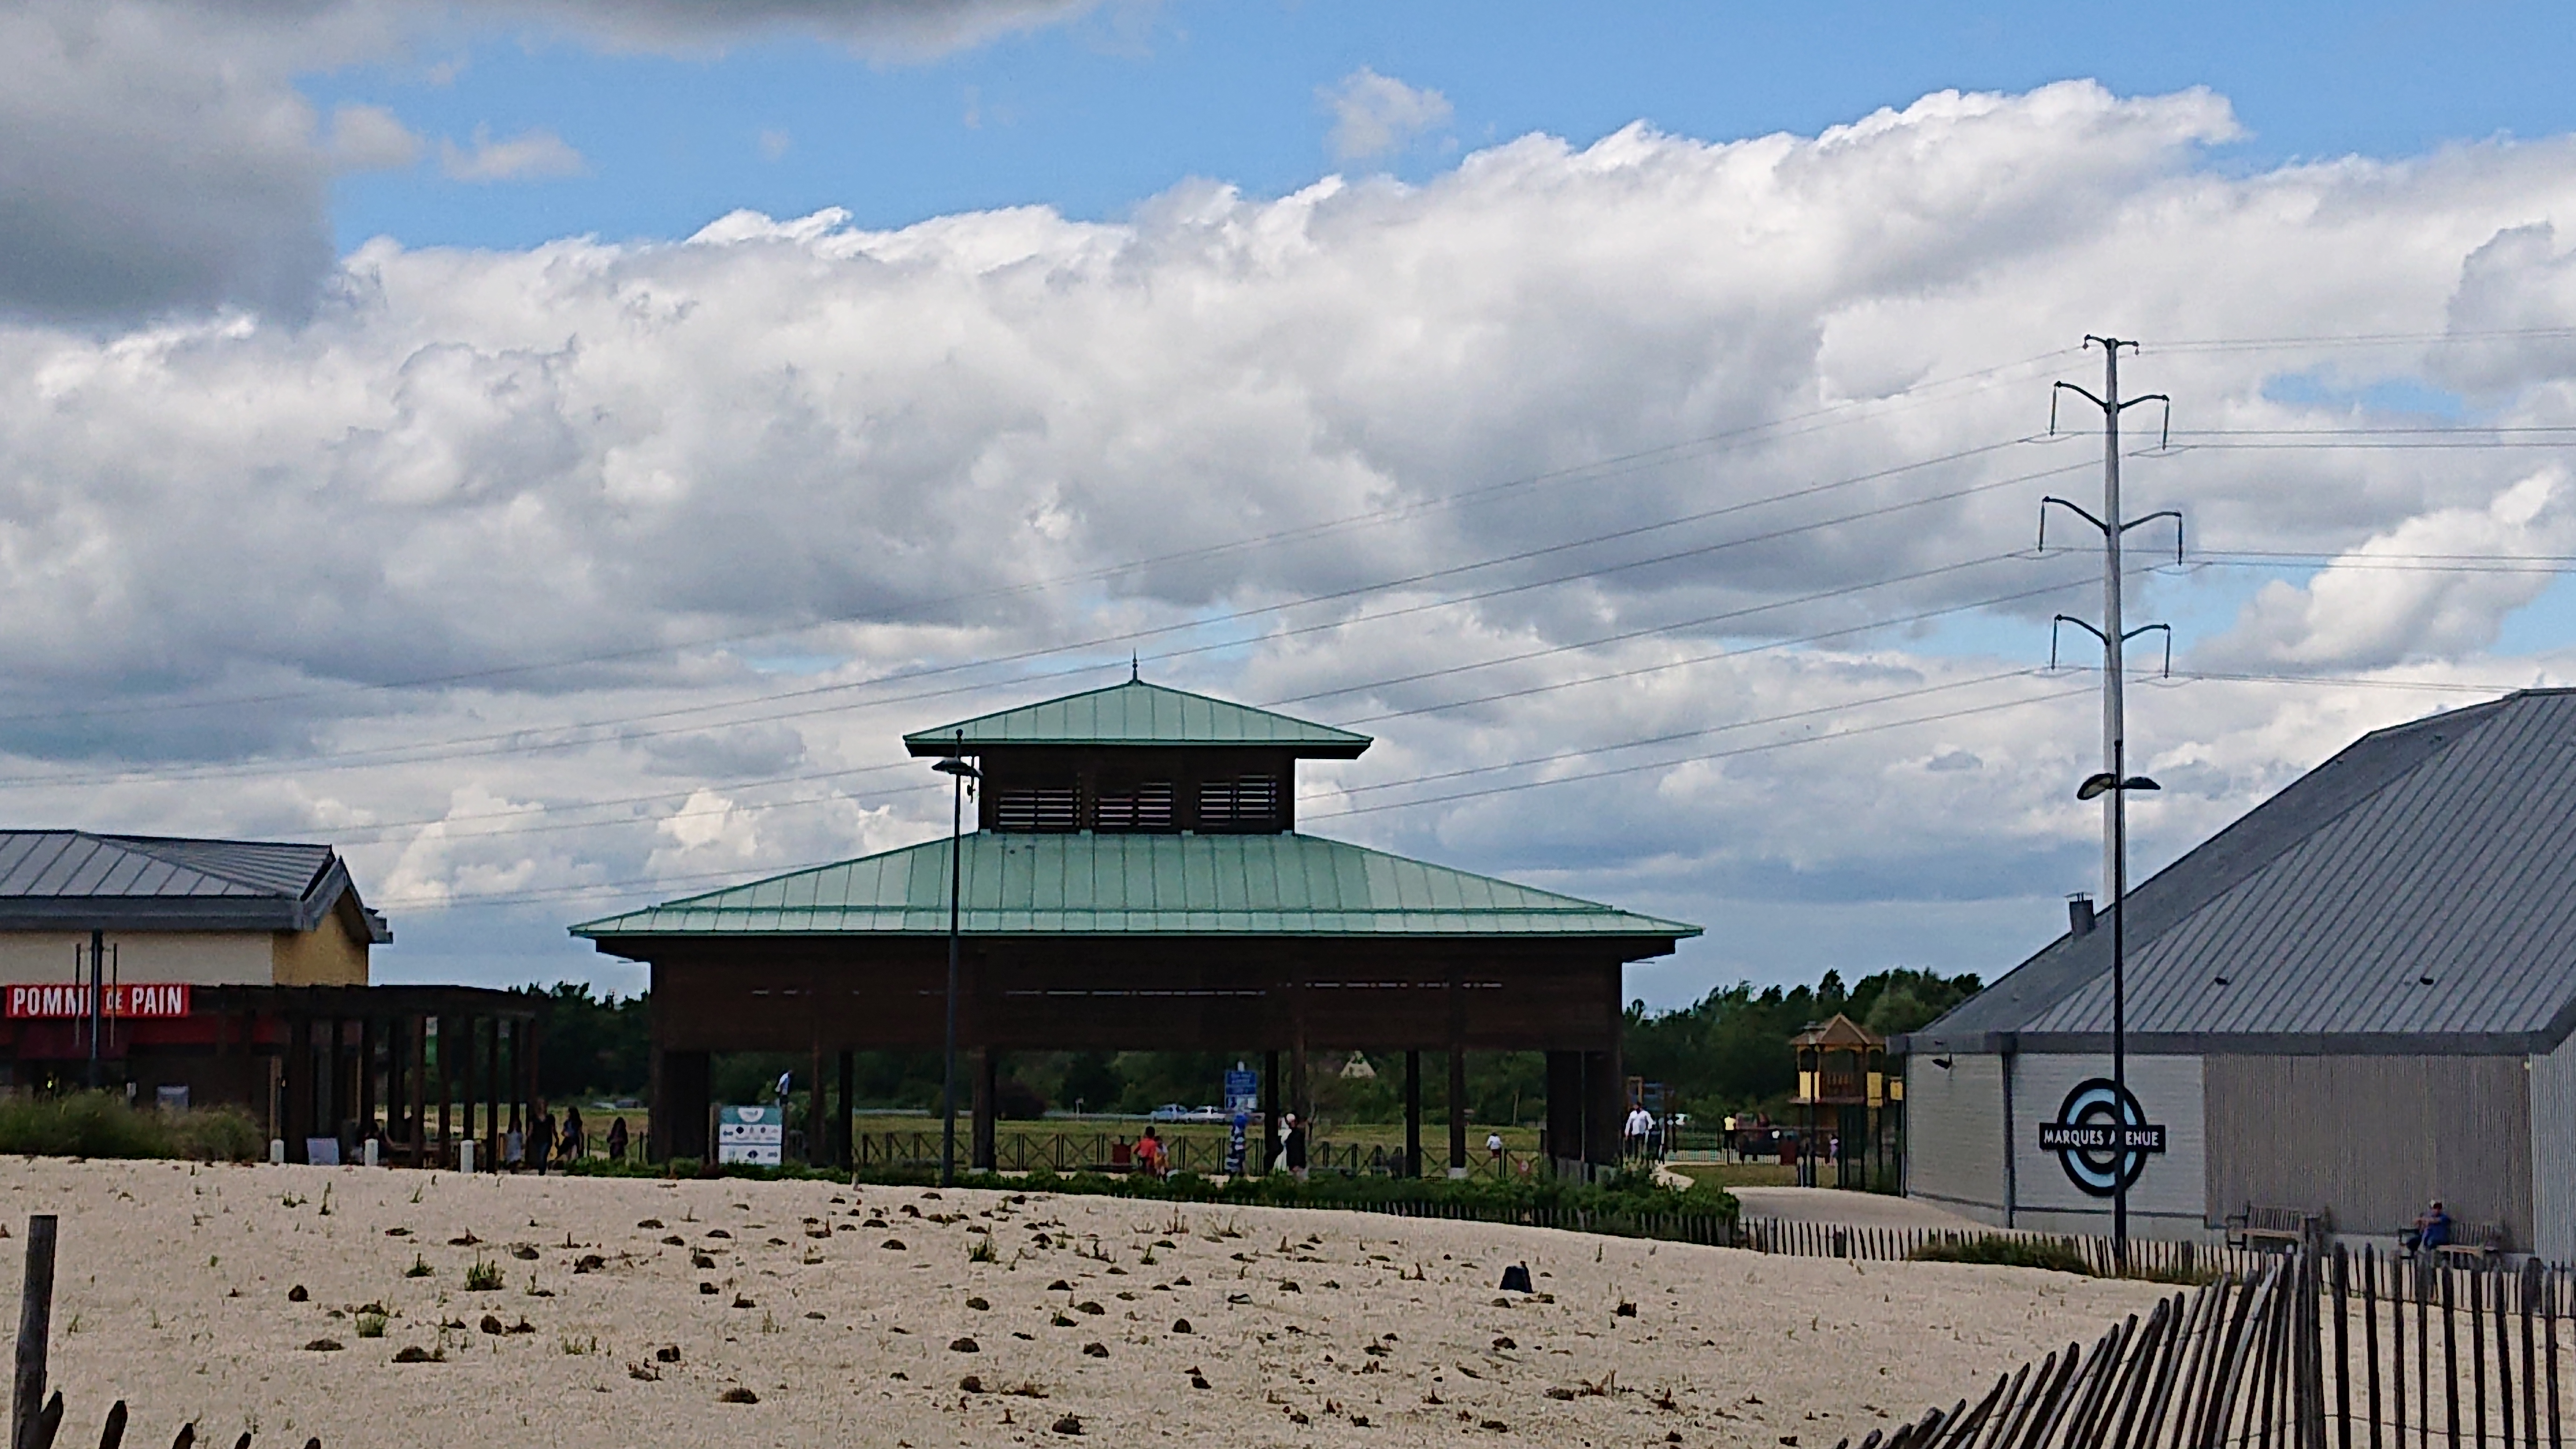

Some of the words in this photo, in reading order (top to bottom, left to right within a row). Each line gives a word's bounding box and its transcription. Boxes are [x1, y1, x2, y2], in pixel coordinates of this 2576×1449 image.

[132, 986, 182, 1014] PAIN
[2044, 1129, 2104, 1147] MARQUES
[2109, 1130, 2159, 1146] AENUE
